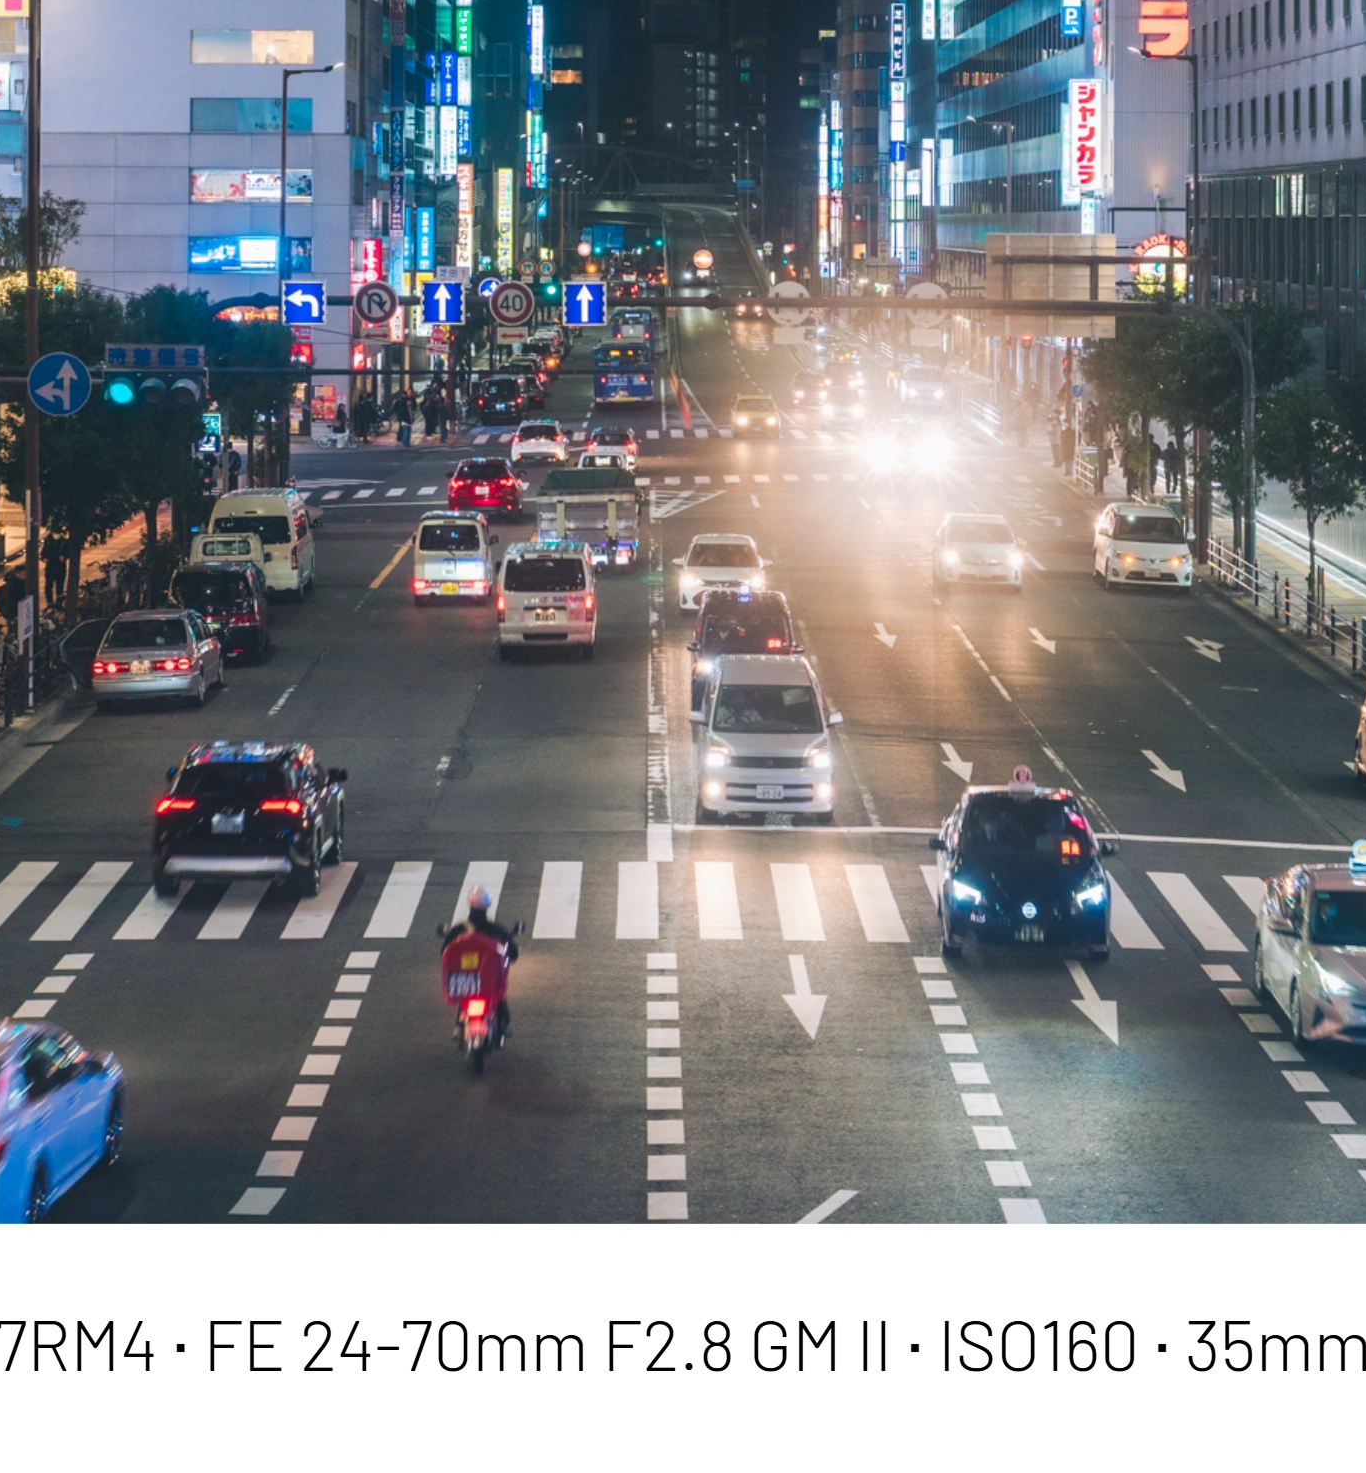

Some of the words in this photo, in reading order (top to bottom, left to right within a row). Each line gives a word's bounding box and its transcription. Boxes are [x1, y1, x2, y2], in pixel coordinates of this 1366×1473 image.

[1077, 83, 1096, 185] ジャンカラ
[499, 294, 524, 312] 40
[108, 347, 201, 367] 時差信号
